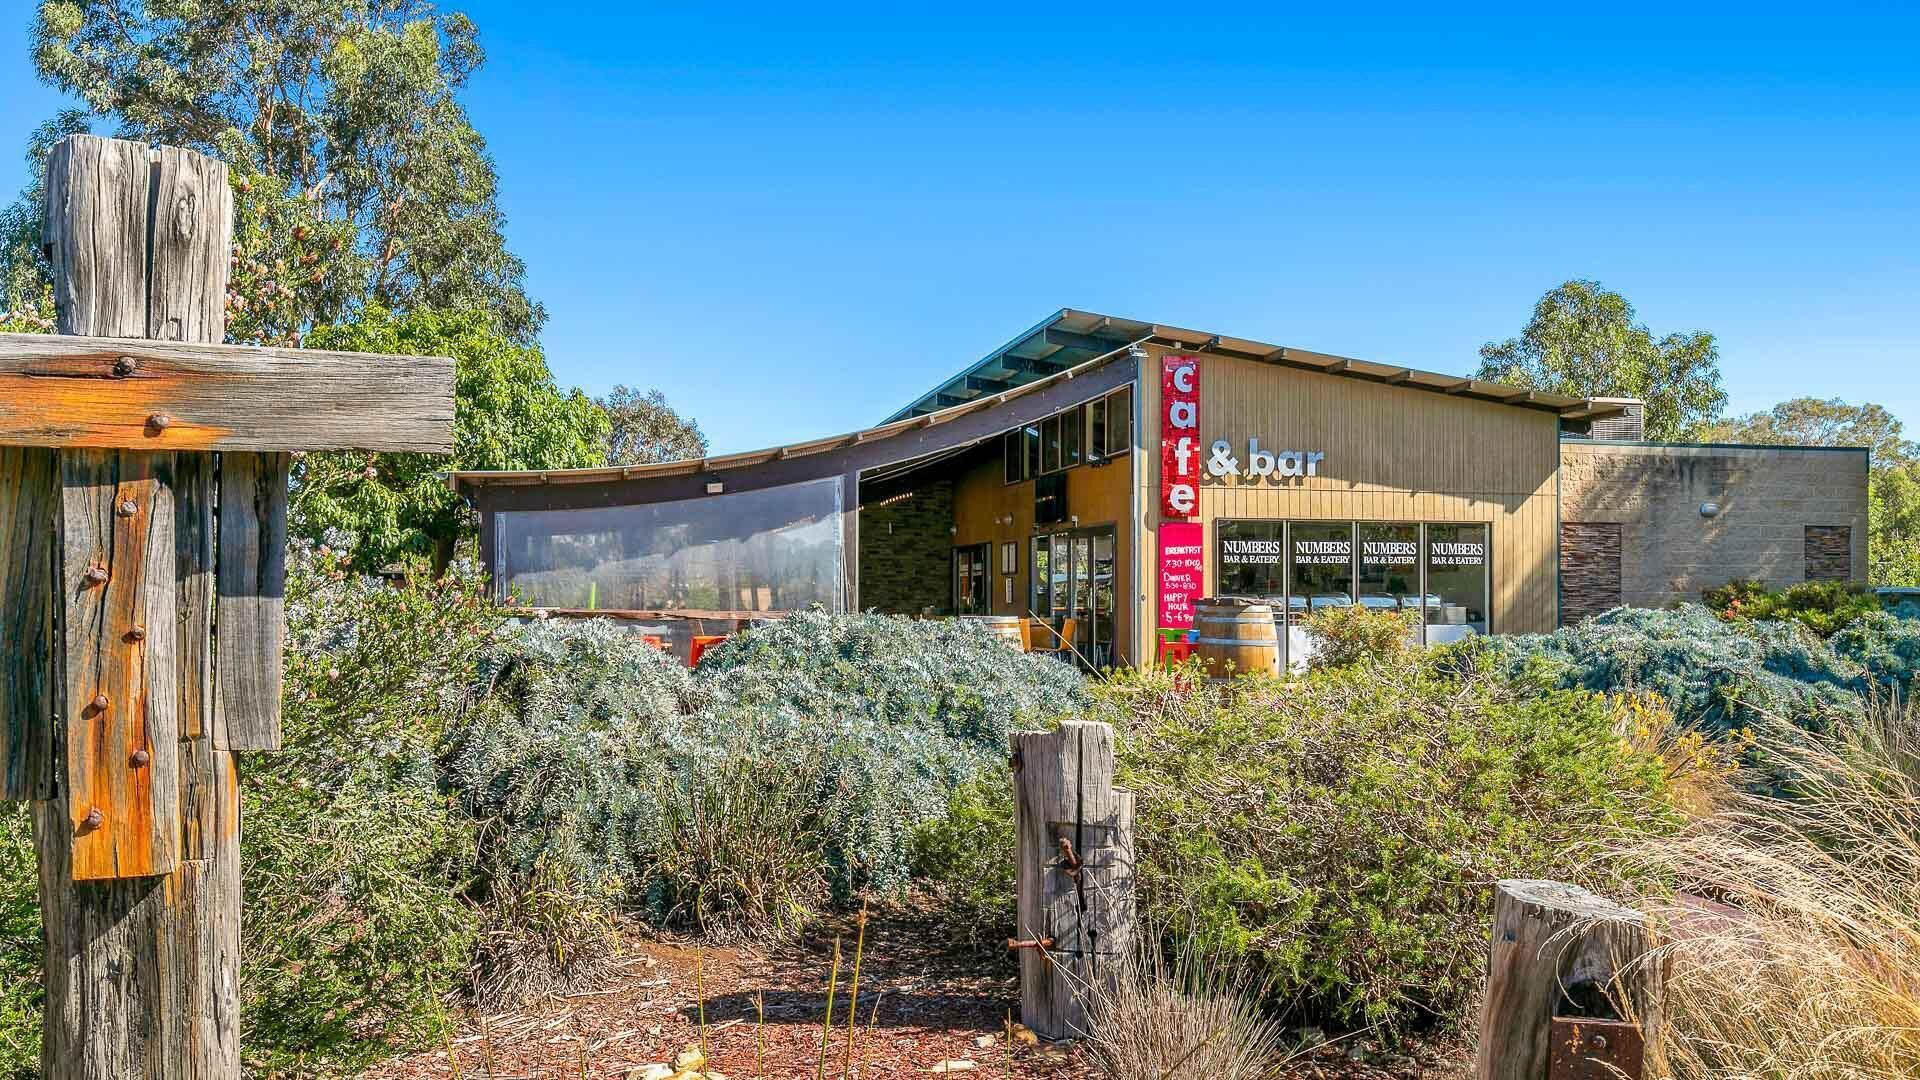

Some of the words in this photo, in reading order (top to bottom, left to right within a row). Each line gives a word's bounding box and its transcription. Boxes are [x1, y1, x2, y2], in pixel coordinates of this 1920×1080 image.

[1169, 366, 1196, 513] cafe
[1207, 440, 1241, 477] &
[1248, 437, 1324, 478] bar
[1223, 540, 1280, 554] NUMBERS
[1295, 541, 1351, 555] NUMBERS
[1363, 542, 1417, 555] NUMBERS
[1431, 542, 1484, 556] NUMBERS
[1223, 555, 1240, 564] BAR
[1241, 555, 1249, 564] &
[1249, 555, 1280, 564] EATERY
[1296, 555, 1312, 564] BAR
[1312, 555, 1320, 564] &
[1320, 555, 1351, 564] EATERY
[1363, 556, 1379, 565] BAR
[1379, 556, 1387, 565] &
[1388, 556, 1417, 565] EATERY
[1432, 556, 1447, 565] BAR
[1448, 556, 1455, 565] &
[1455, 556, 1484, 565] EATERY
[1163, 592, 1188, 602] HAPPY
[1167, 602, 1189, 611] HOUR
